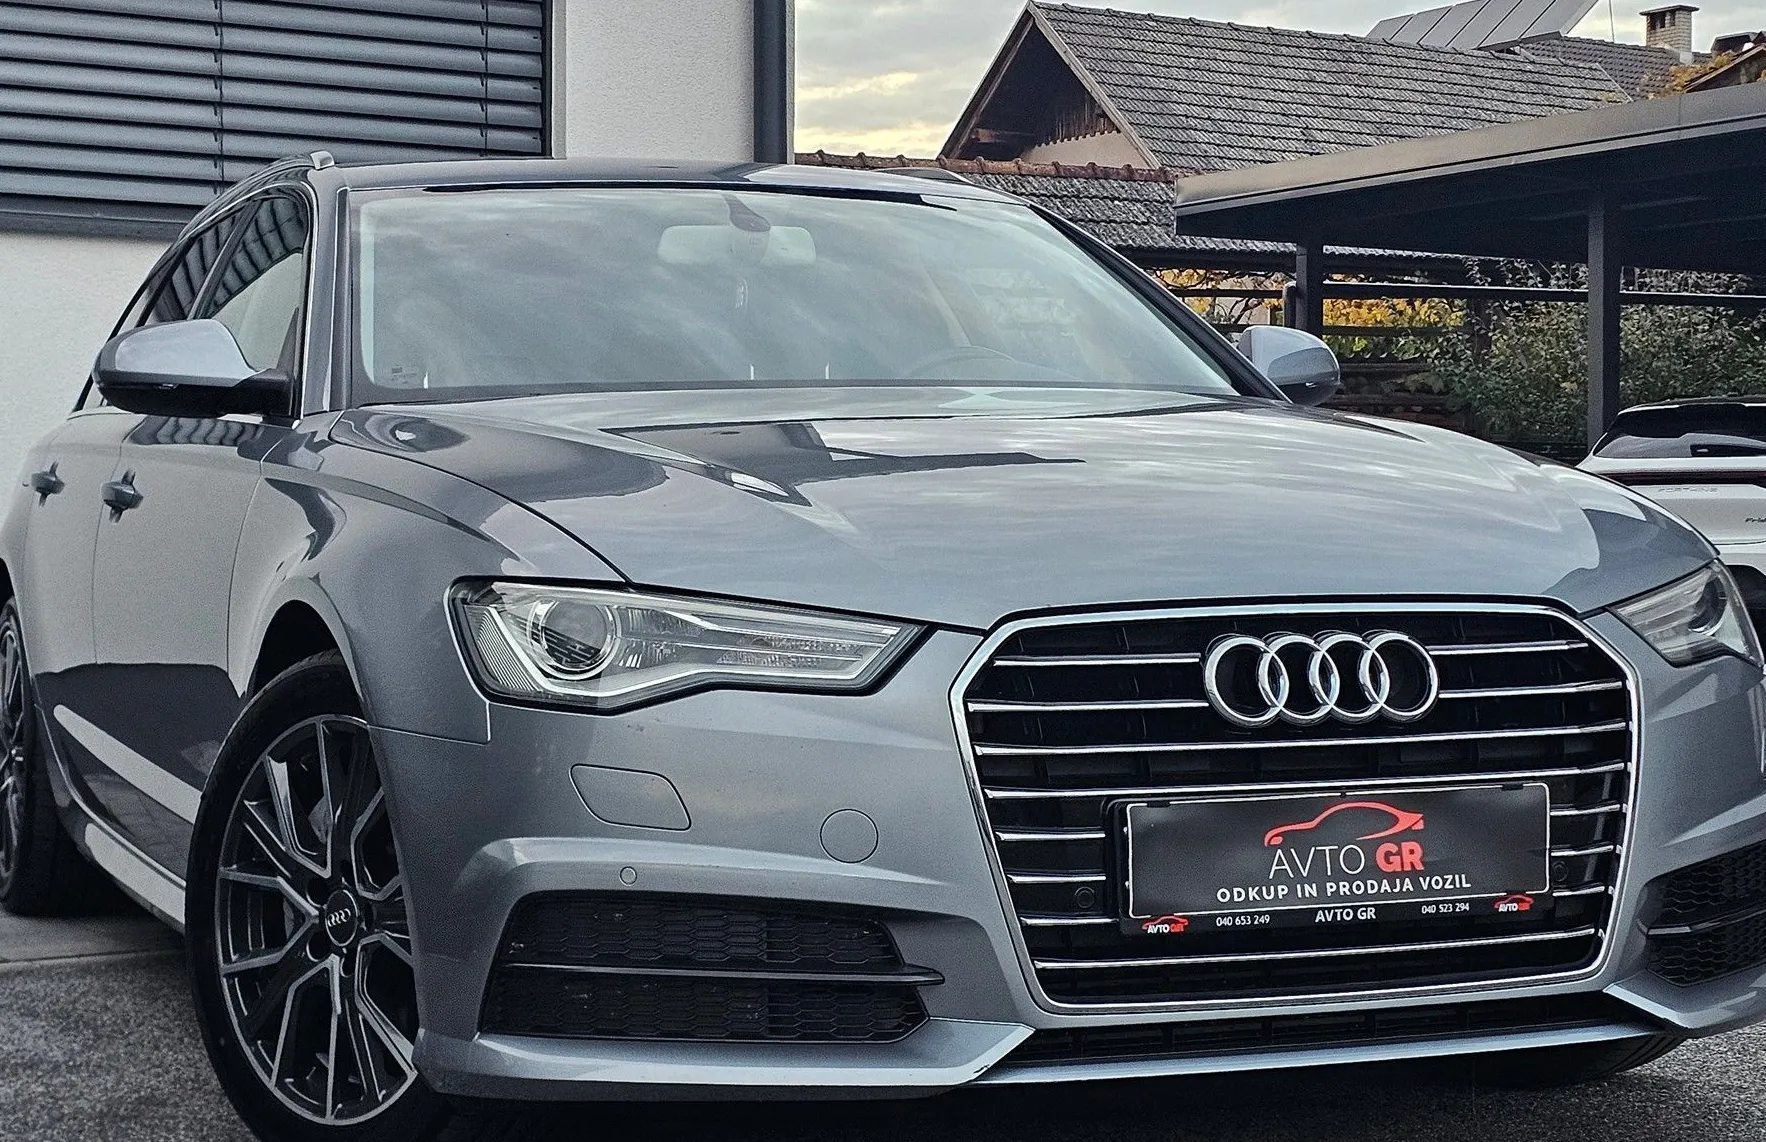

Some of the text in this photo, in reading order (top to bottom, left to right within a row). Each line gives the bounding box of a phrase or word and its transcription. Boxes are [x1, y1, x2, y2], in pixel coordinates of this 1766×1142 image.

[1269, 842, 1425, 879] AVTO GR
[1216, 874, 1472, 903] ODKUP IN PRODAJA VOZIL
[1315, 907, 1376, 923] AVTO GR
[1421, 902, 1470, 914] 040 523 294
[1216, 914, 1270, 927] 040 653 249
[1147, 923, 1170, 934] AVTO
